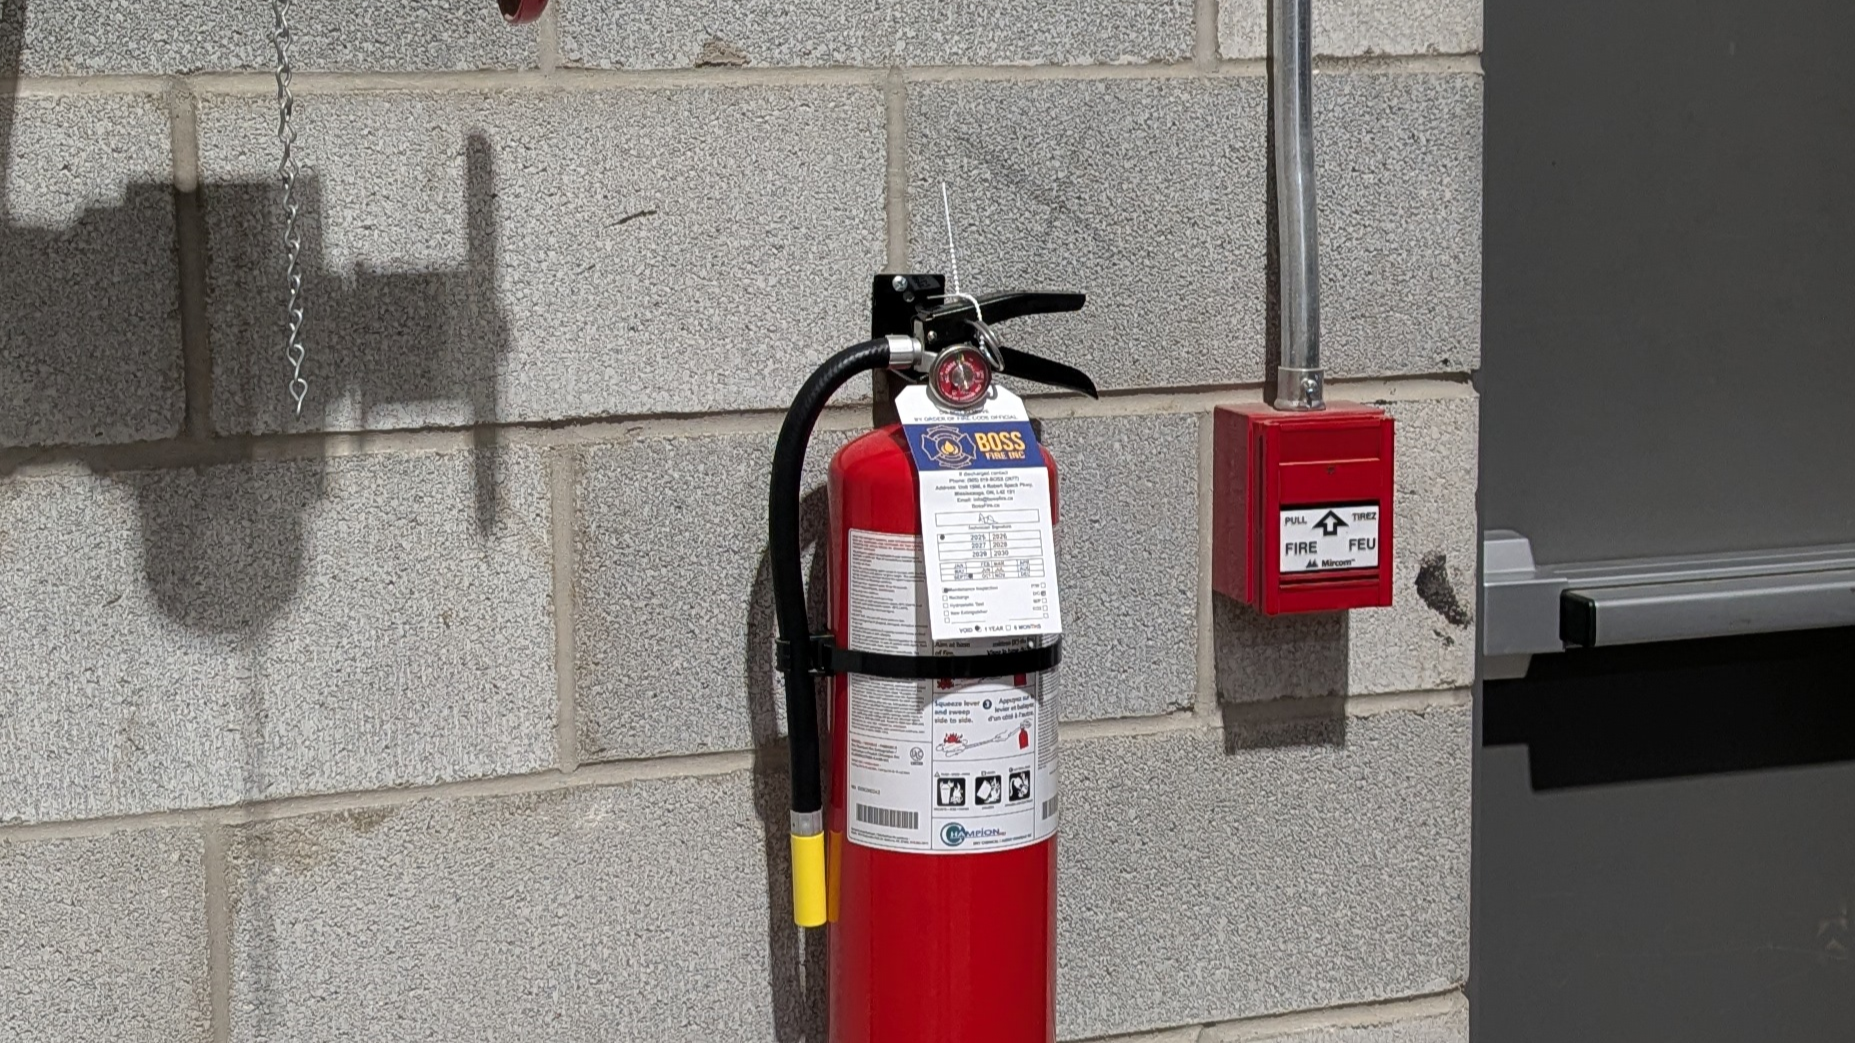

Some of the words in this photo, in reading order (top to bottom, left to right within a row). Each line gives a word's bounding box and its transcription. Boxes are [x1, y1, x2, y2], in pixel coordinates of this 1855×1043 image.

[974, 431, 1026, 452] BOSS
[985, 451, 1007, 460] FIRE
[1008, 450, 1026, 459] INC
[1284, 516, 1307, 526] PULL
[1352, 511, 1377, 521] TIREZ
[1285, 541, 1318, 555] FIRE
[1348, 537, 1376, 552] FEU
[940, 822, 1000, 847] CHAMPION
